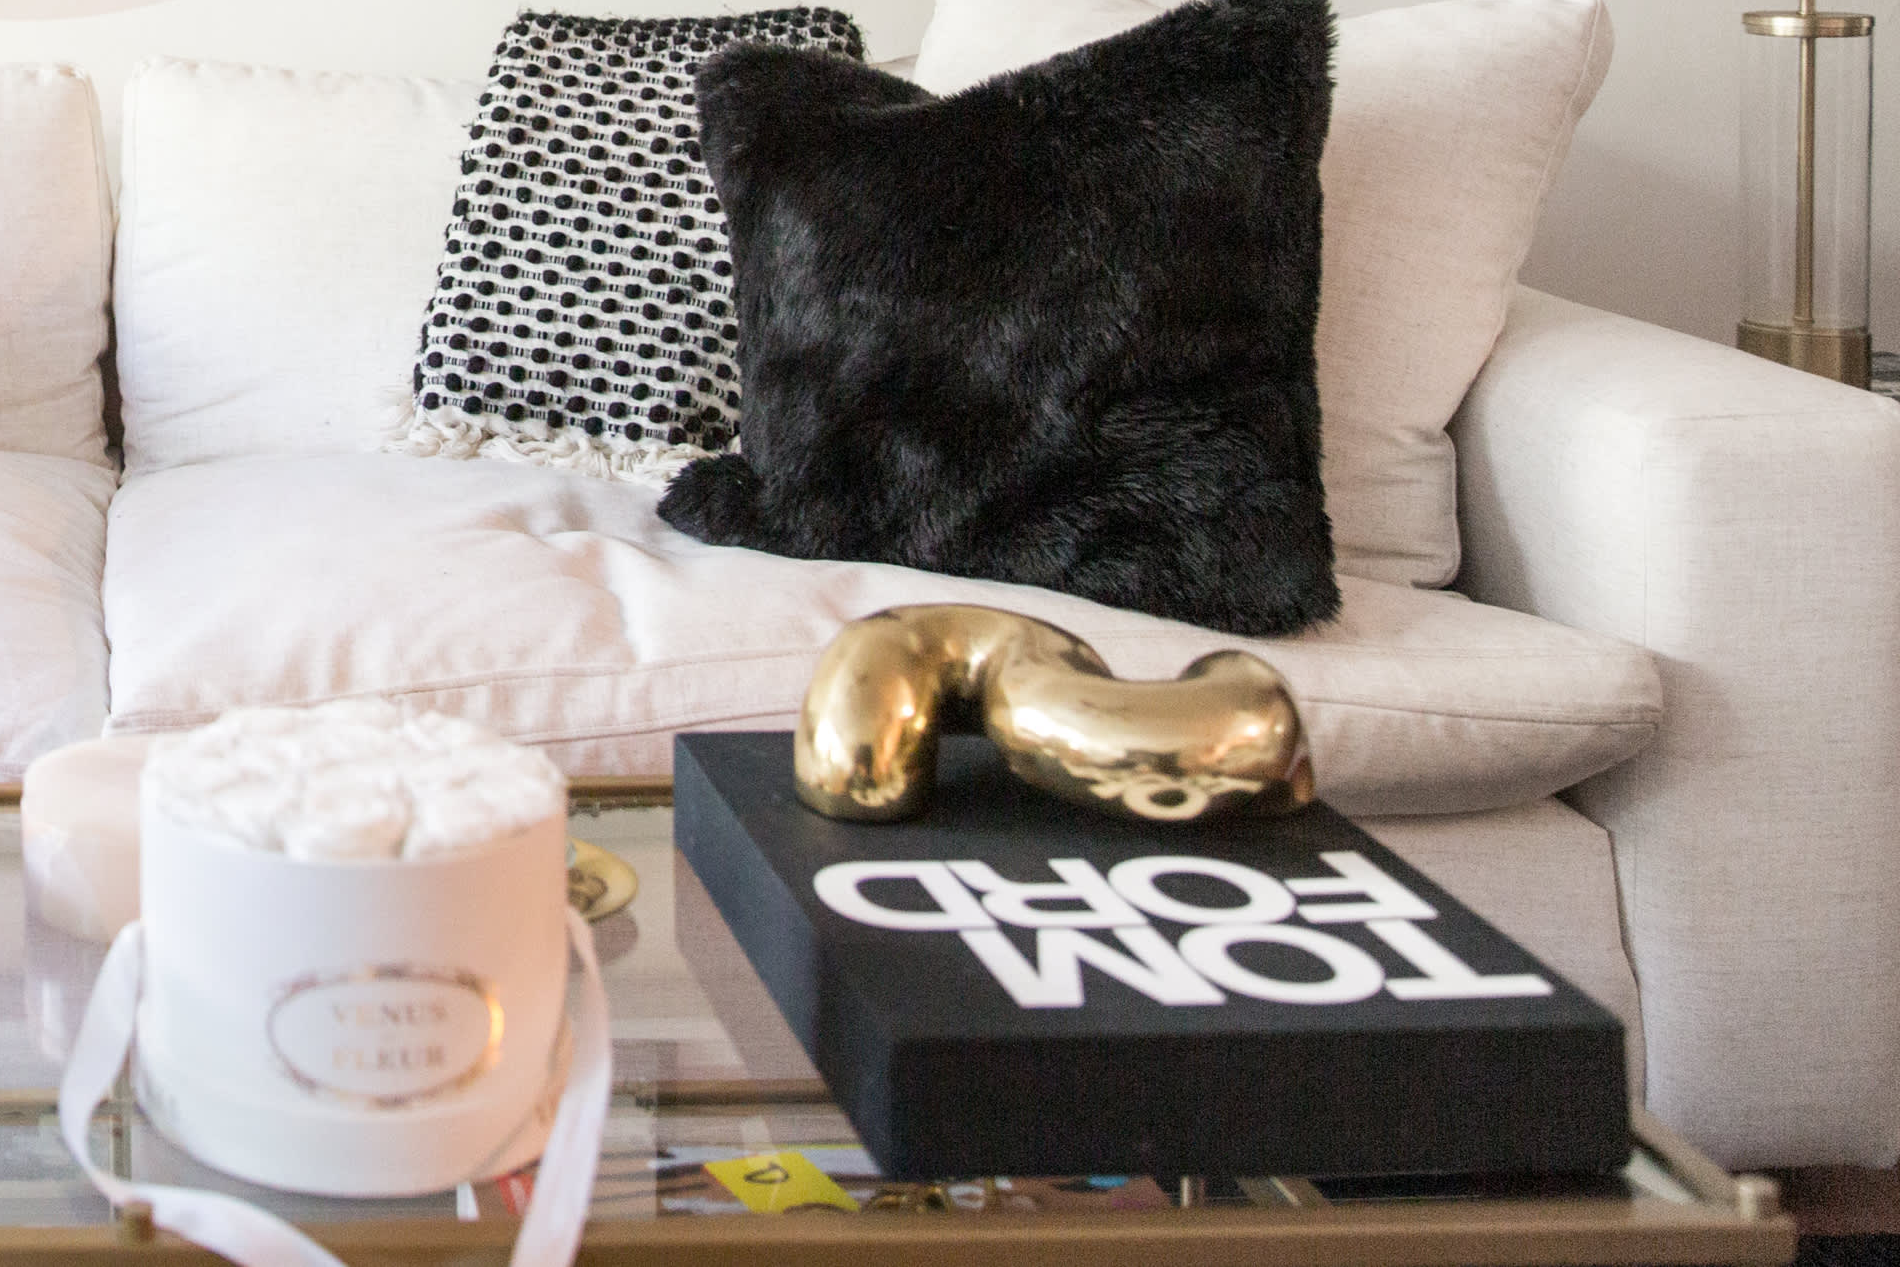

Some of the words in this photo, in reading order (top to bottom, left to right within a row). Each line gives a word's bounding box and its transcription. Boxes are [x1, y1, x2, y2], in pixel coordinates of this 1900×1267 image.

[813, 850, 1439, 932] FORD
[957, 917, 1555, 1009] TOM
[331, 1002, 449, 1027] VENUS
[331, 1044, 448, 1070] FLEUR
